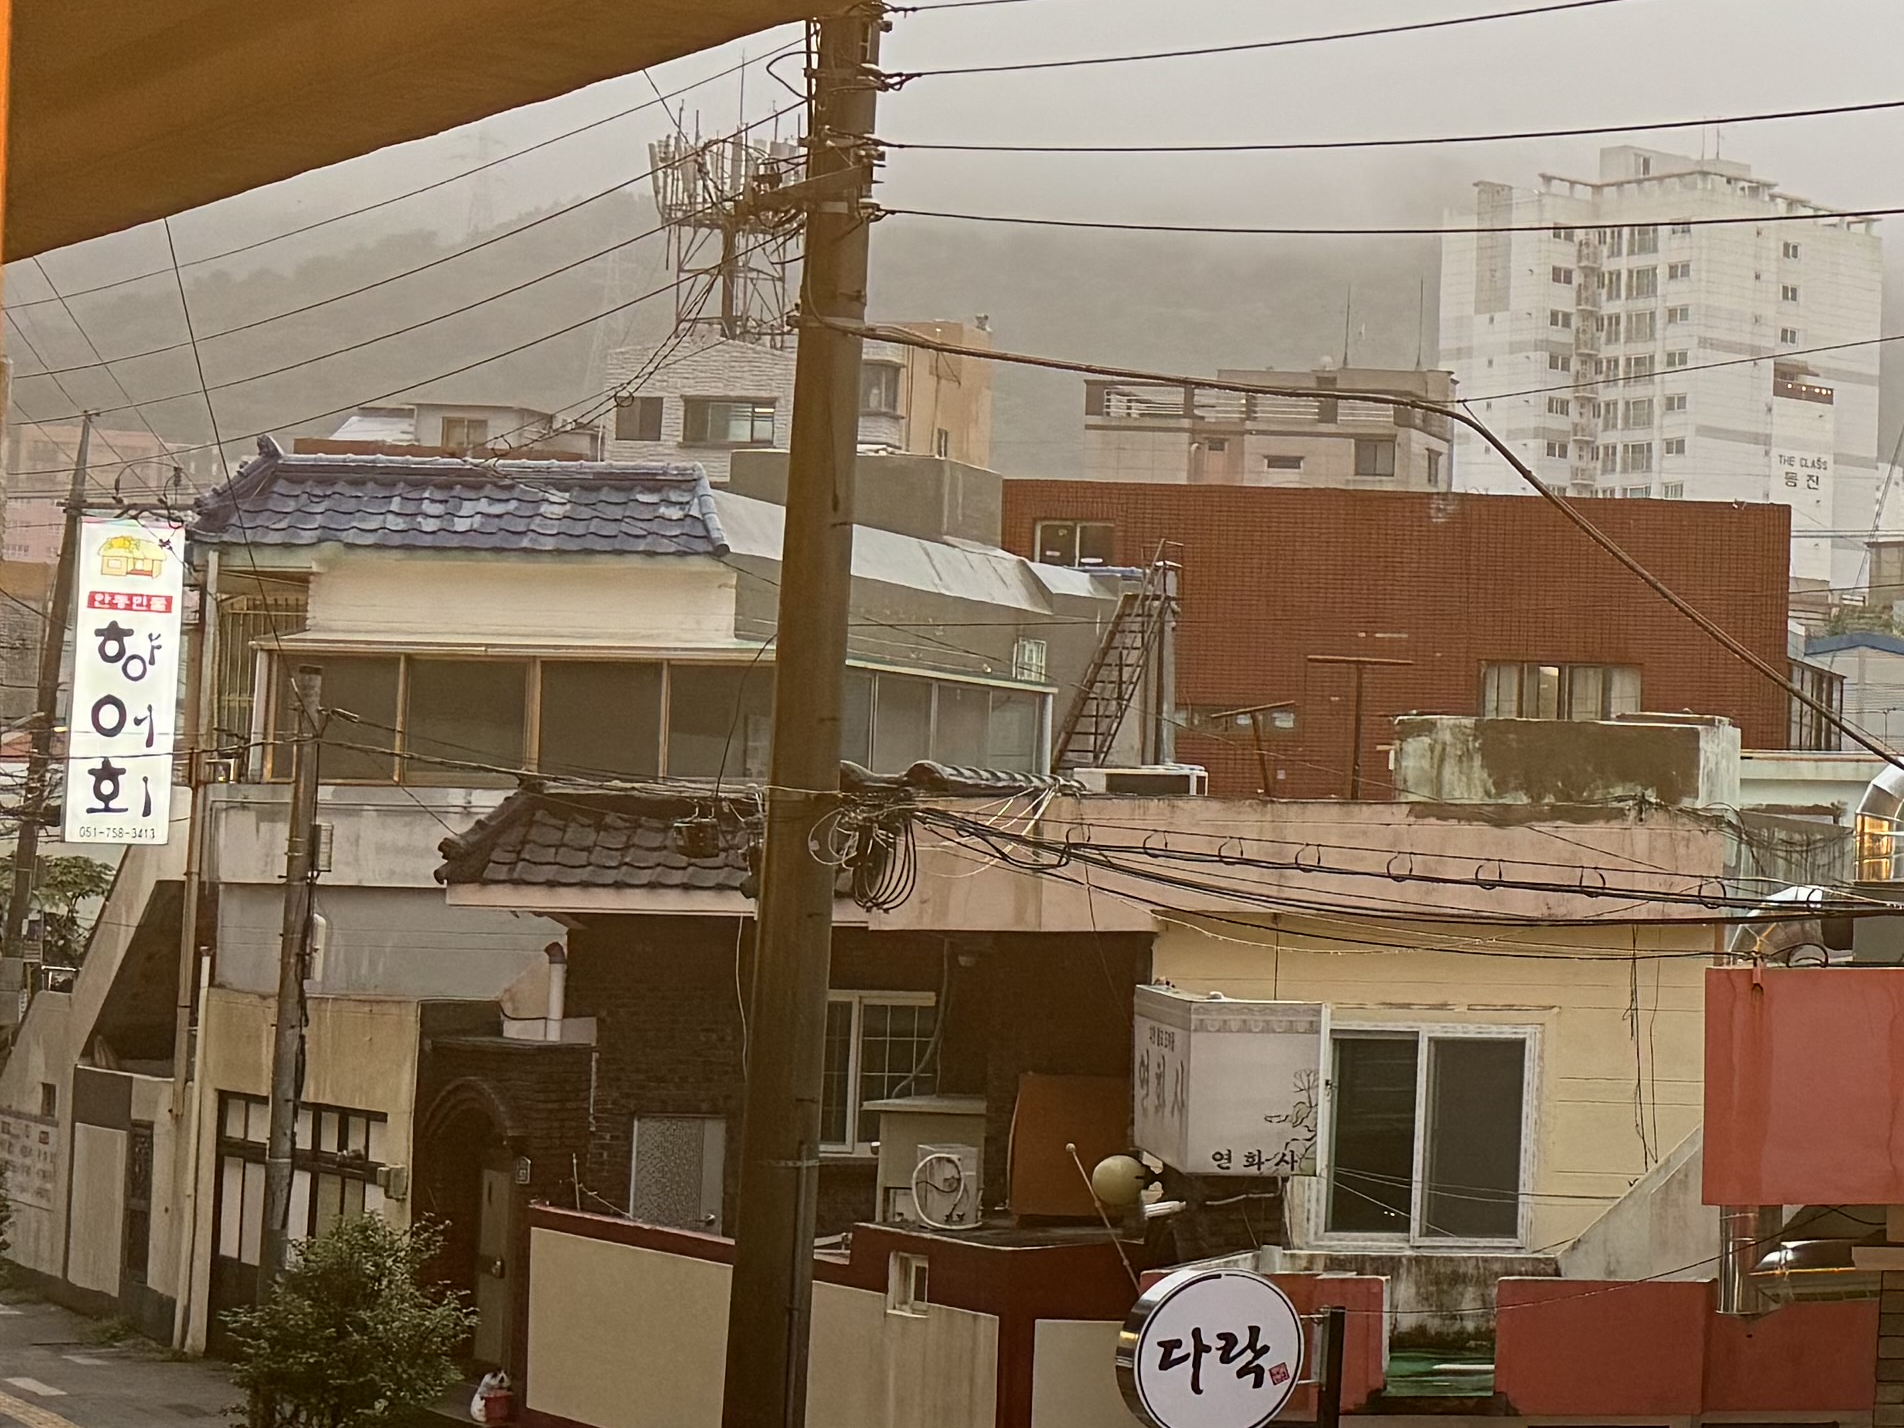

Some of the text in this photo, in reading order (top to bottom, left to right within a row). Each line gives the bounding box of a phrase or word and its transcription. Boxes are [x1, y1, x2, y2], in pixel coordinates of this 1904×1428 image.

[1778, 454, 1827, 470] THE CLASS
[86, 620, 163, 817] 향어회
[1212, 1149, 1298, 1171] 연화사
[1157, 1325, 1271, 1395] 다락
